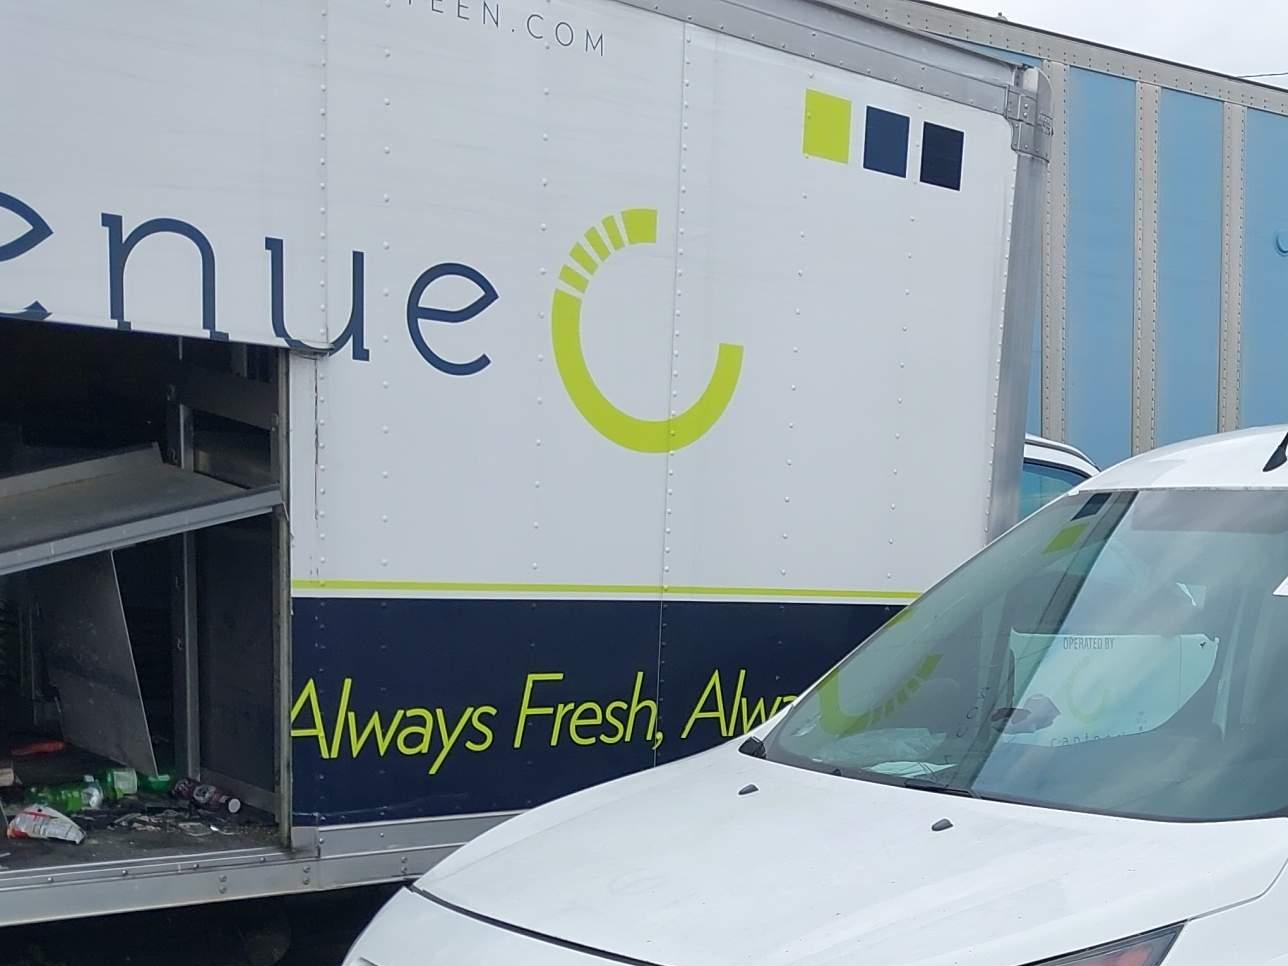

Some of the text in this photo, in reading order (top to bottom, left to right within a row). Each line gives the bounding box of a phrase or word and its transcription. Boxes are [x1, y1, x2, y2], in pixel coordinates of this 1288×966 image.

[1063, 636, 1114, 650] OPERATED BY
[290, 668, 798, 775] Always Fresh, Alw
